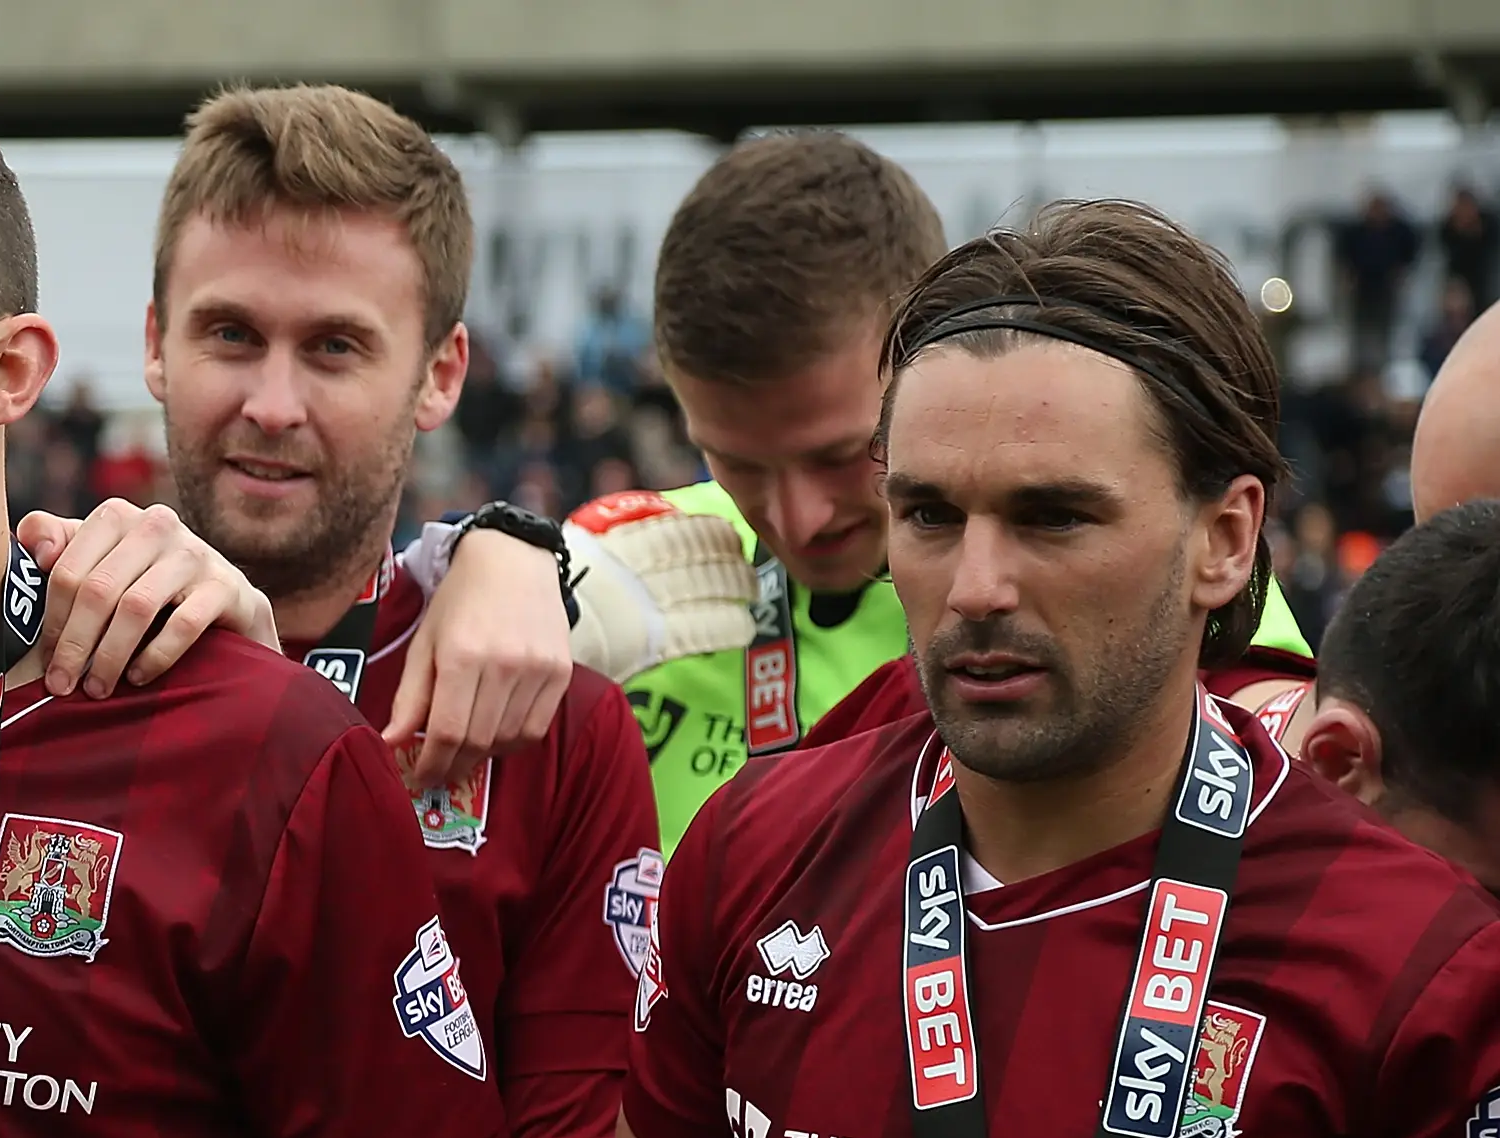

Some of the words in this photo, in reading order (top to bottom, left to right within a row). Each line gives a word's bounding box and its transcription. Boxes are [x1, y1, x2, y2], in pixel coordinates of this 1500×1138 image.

[704, 713, 745, 743] TH
[753, 650, 790, 741] BET
[691, 745, 740, 777] OF
[1194, 730, 1249, 821] sky
[611, 892, 643, 926] sky
[910, 864, 956, 951] sky
[746, 974, 818, 1012] errea
[1143, 892, 1212, 1012] BET
[405, 985, 445, 1025] sky
[913, 968, 966, 1092] BET
[1118, 1024, 1187, 1126] sky
